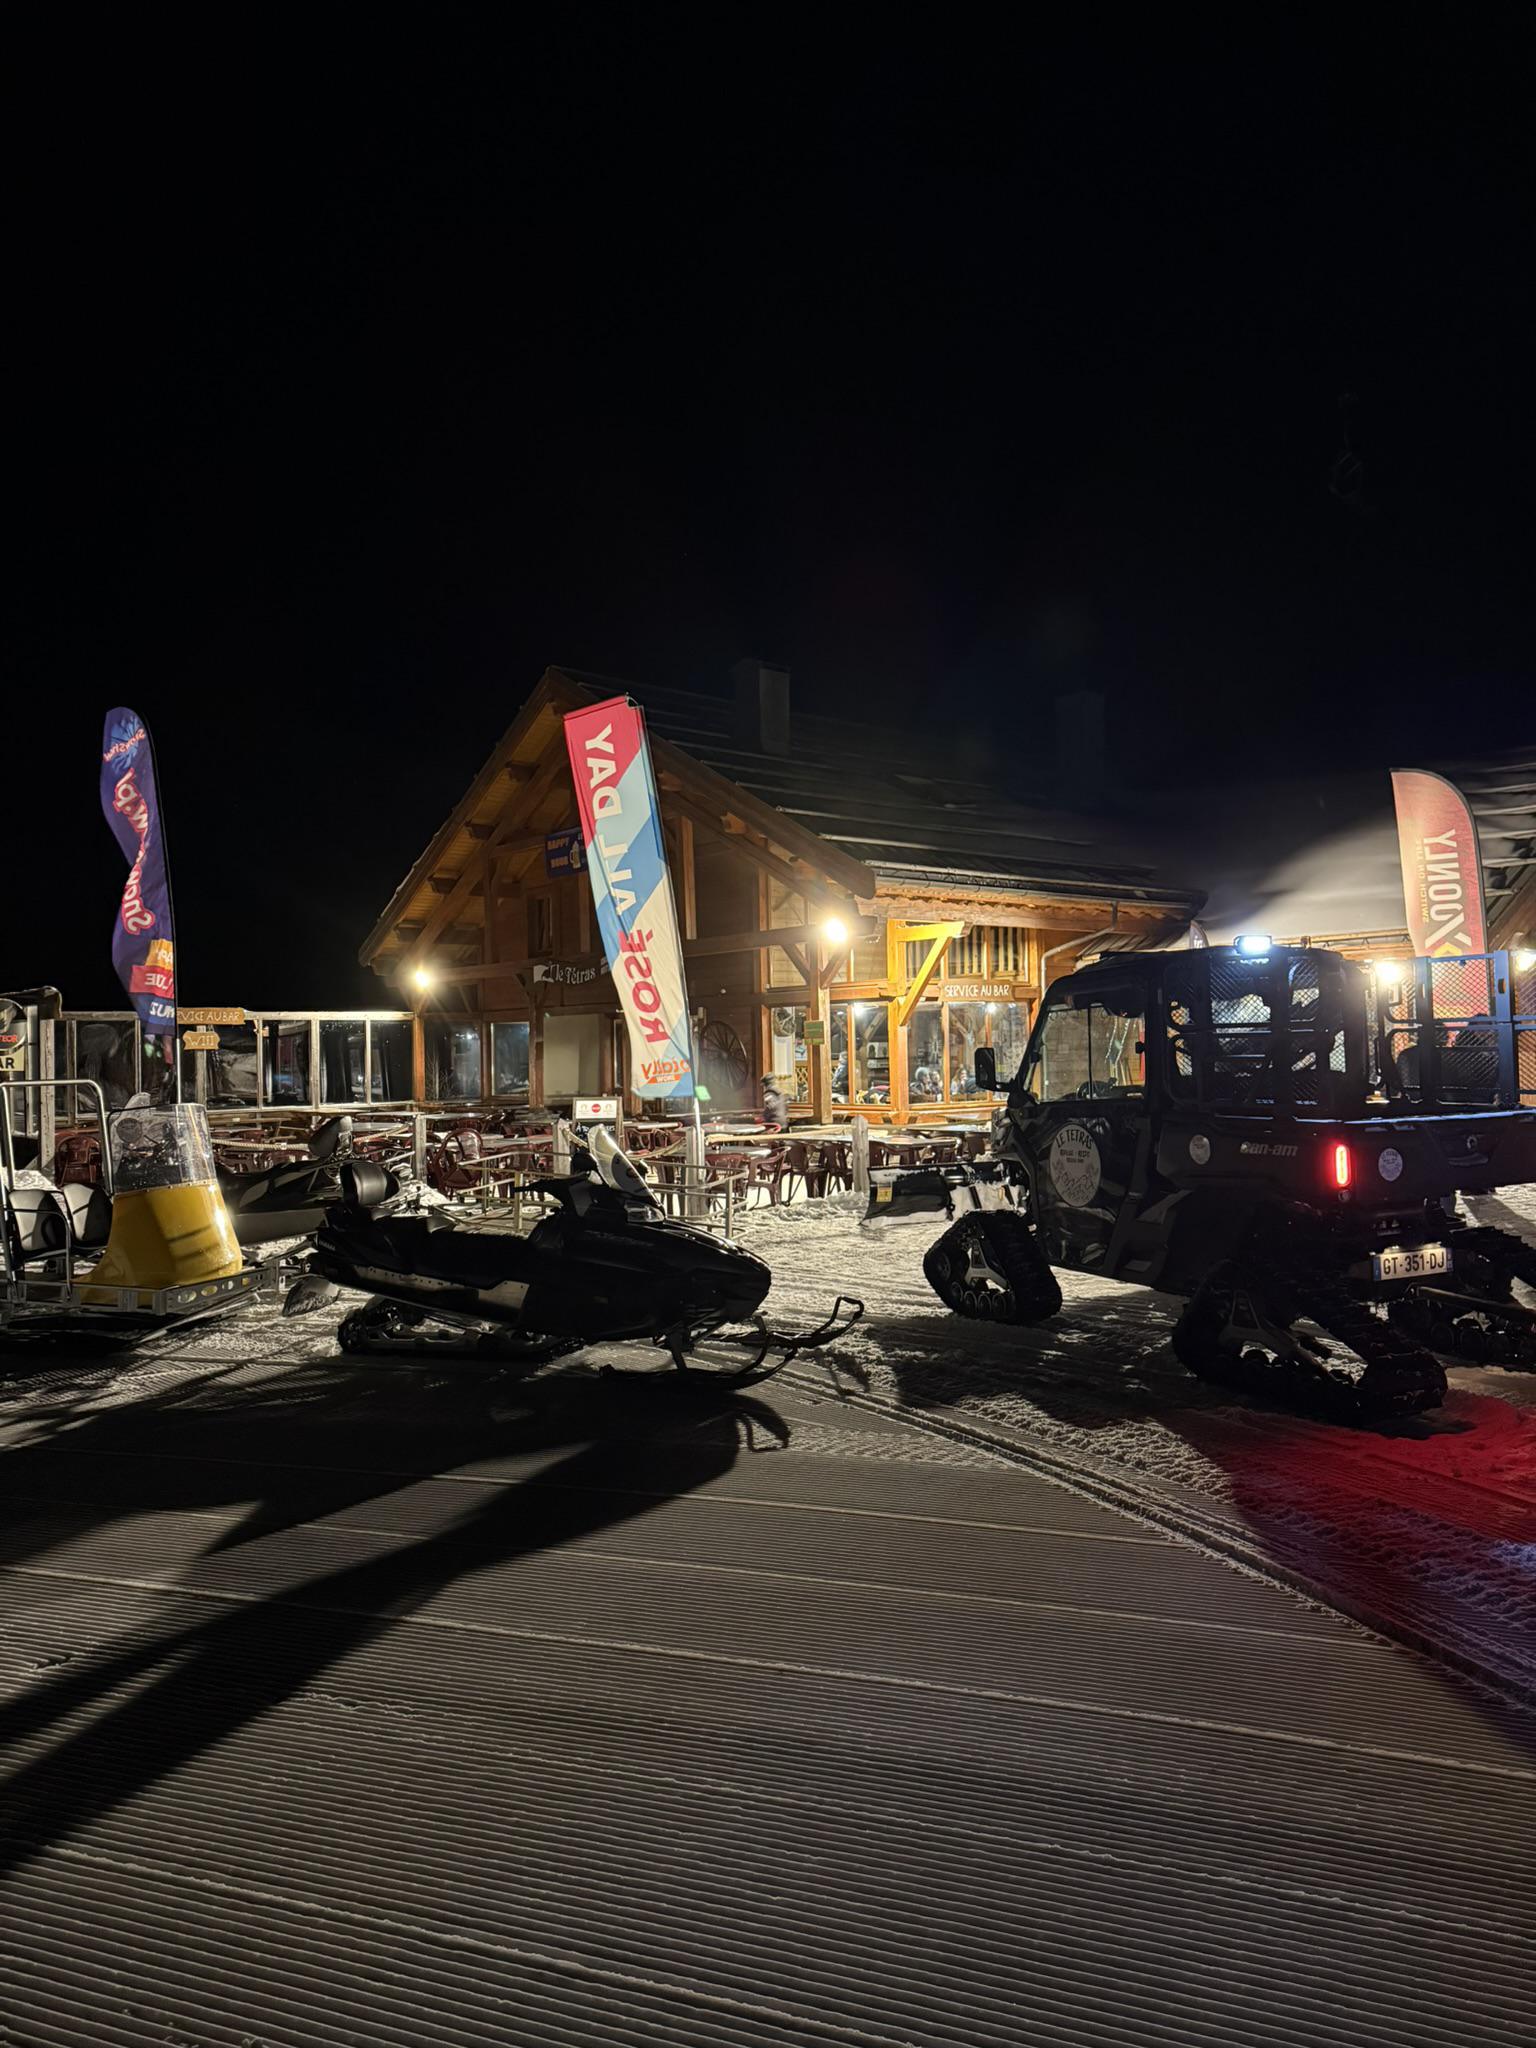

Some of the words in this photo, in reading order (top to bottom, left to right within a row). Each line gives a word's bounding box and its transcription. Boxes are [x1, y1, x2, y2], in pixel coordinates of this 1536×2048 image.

[944, 984, 978, 997] SERVICE
[980, 985, 992, 996] AU
[993, 984, 1010, 996] BAR
[206, 1011, 221, 1021] AU
[222, 1011, 240, 1021] BAR
[0, 1057, 14, 1069] AR
[1056, 1132, 1065, 1149] LE
[1066, 1129, 1093, 1150] TETRAS
[1383, 1251, 1445, 1275] GT-351-DJ
